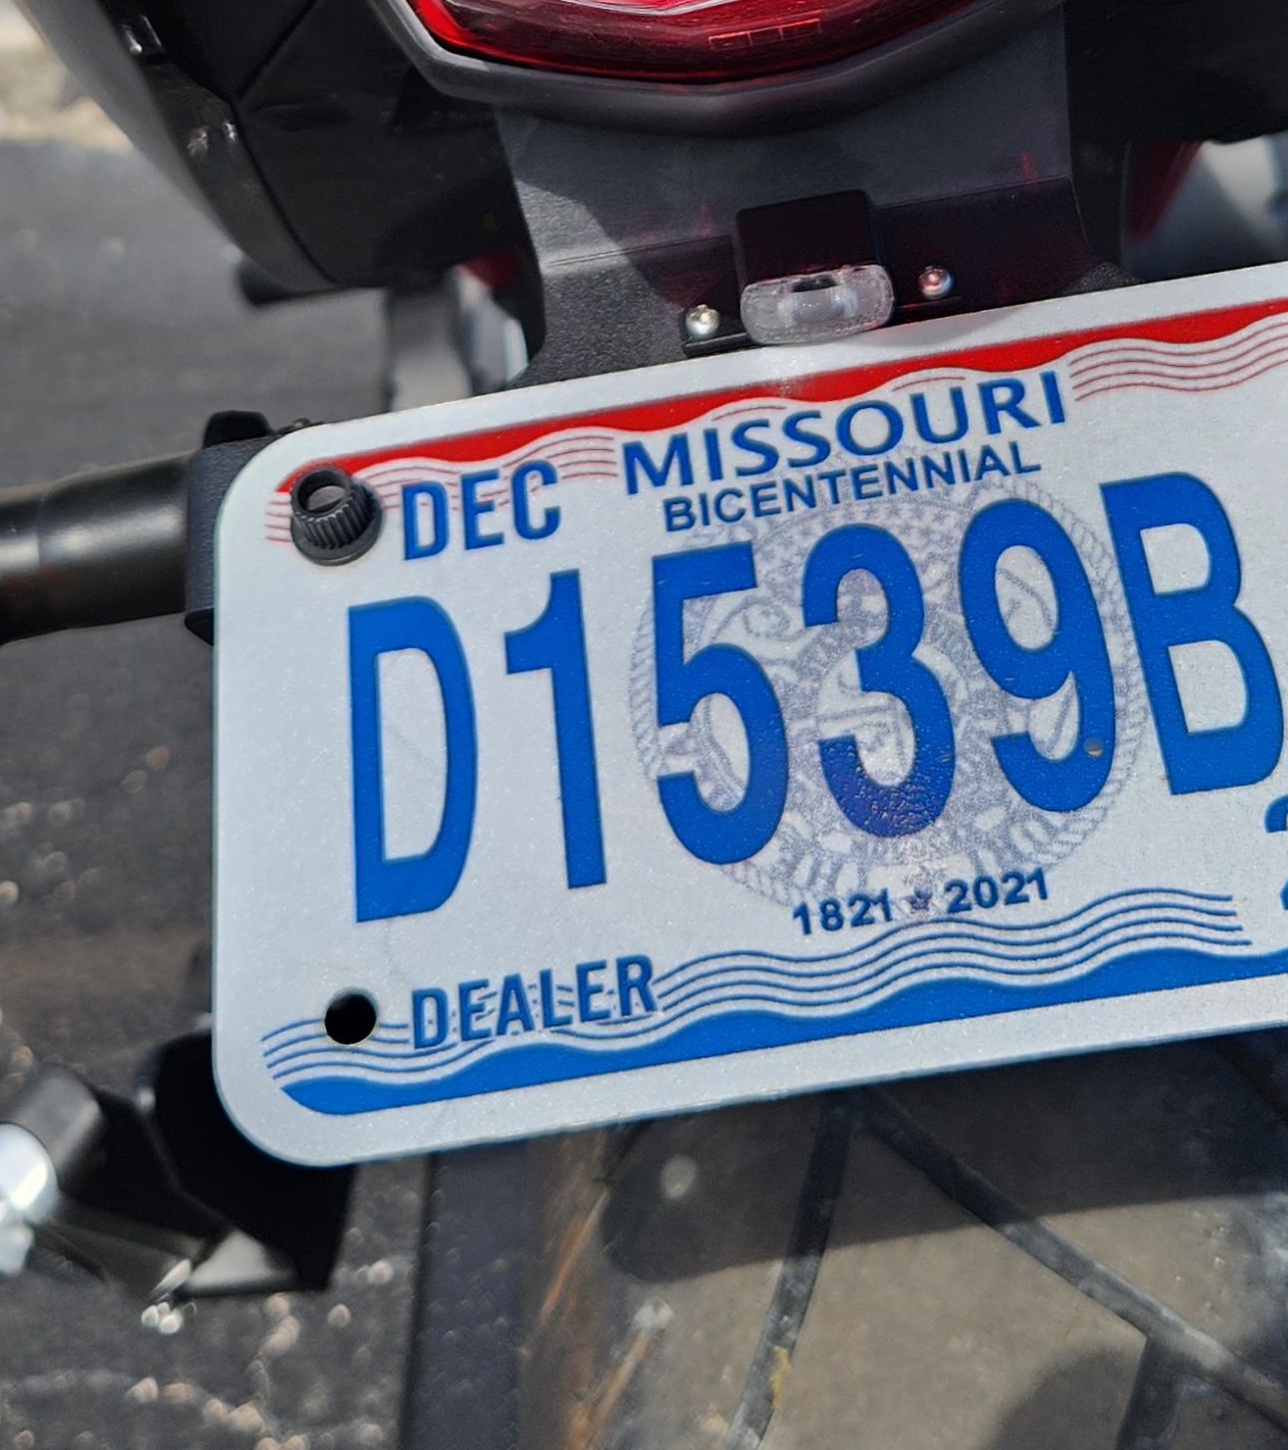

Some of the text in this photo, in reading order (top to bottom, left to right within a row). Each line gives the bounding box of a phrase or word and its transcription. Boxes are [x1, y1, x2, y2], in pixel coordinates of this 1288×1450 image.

[622, 370, 1067, 497] MISSOURI
[401, 460, 561, 562] DEC
[662, 441, 1042, 534] BICENTENNIAL
[791, 866, 1049, 936] 1821 2021
[411, 953, 658, 1050] DEALER
